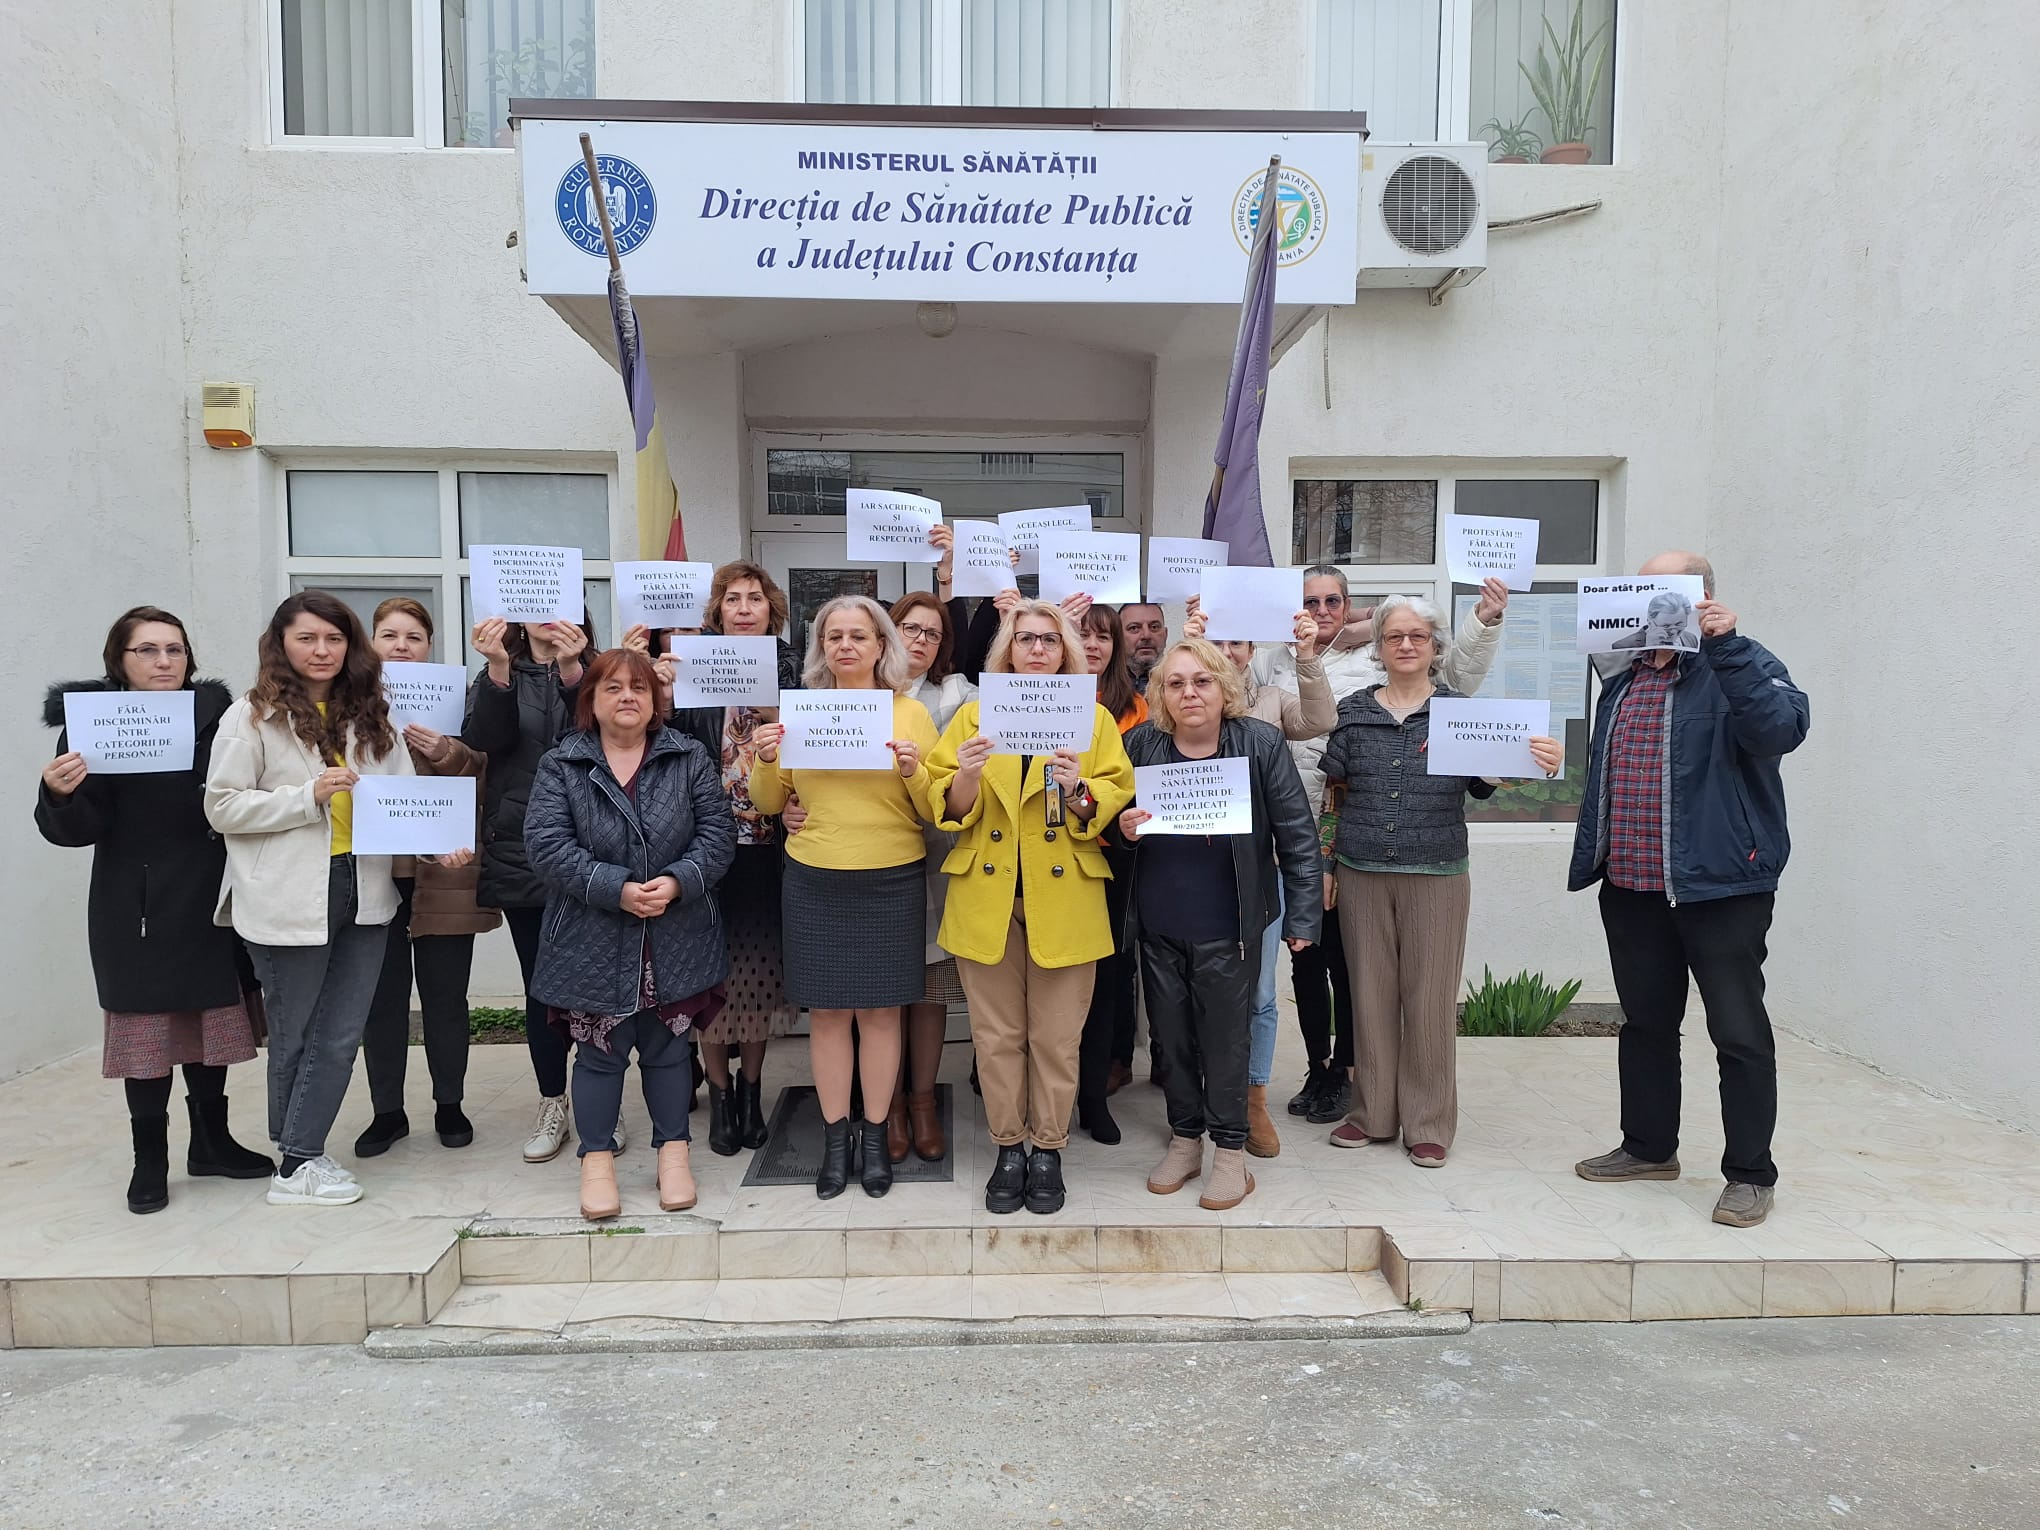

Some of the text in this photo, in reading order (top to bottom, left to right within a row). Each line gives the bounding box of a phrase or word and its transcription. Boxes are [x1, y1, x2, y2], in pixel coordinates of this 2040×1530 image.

[798, 150, 1097, 180] MINISTERUL SĂNĂTĂȚII
[1252, 178, 1265, 189] DE
[1278, 172, 1311, 192] NĂTATE
[697, 187, 1194, 231] Direcția de Sănătate Publică
[756, 238, 1138, 284] a Județului Constanța
[1462, 528, 1513, 538] PROTESTĂM
[1469, 539, 1492, 548] FĂRĂ
[1088, 552, 1099, 560] SĂ
[1068, 563, 1116, 571] APRECIATĂ
[634, 572, 687, 580] PROTESTĂM
[1075, 574, 1109, 582] MUNCA!
[644, 583, 666, 591] FĂRĂ
[1612, 584, 1633, 592] atât
[1636, 584, 1655, 593] pot
[1589, 618, 1640, 629] NIMIC!
[712, 647, 736, 655] FĂRĂ
[692, 657, 757, 666] DISCRIMINĂRI
[711, 667, 739, 675] ÎNTRE
[410, 682, 421, 690] SĂ
[1007, 680, 1071, 688] ASIMILAREA
[117, 704, 147, 714] FĂRĂ
[395, 703, 434, 711] MUNCA!
[815, 704, 877, 712] SACRIFICAȚI
[94, 715, 171, 727] DISCRIMINĂRI
[832, 715, 840, 724] ȘI
[1448, 721, 1495, 730] PROTEST
[117, 727, 150, 737] ÎNTRE
[808, 727, 864, 736] NICIODATĂ
[999, 731, 1028, 739] VREM
[1455, 733, 1521, 743] CONSTANȚA!
[95, 738, 173, 750] CATEGORII DE
[804, 739, 867, 749] RESPECTAȚI!
[104, 750, 163, 760] PERSONAL!
[1161, 765, 1222, 777] MINISTERUL
[1175, 790, 1218, 799] ALĂTURI
[1221, 788, 1234, 796] DE
[1161, 803, 1178, 811] NOI
[389, 810, 441, 818] DECENTE!
[1162, 812, 1227, 822] DECIZIA ICCJ
